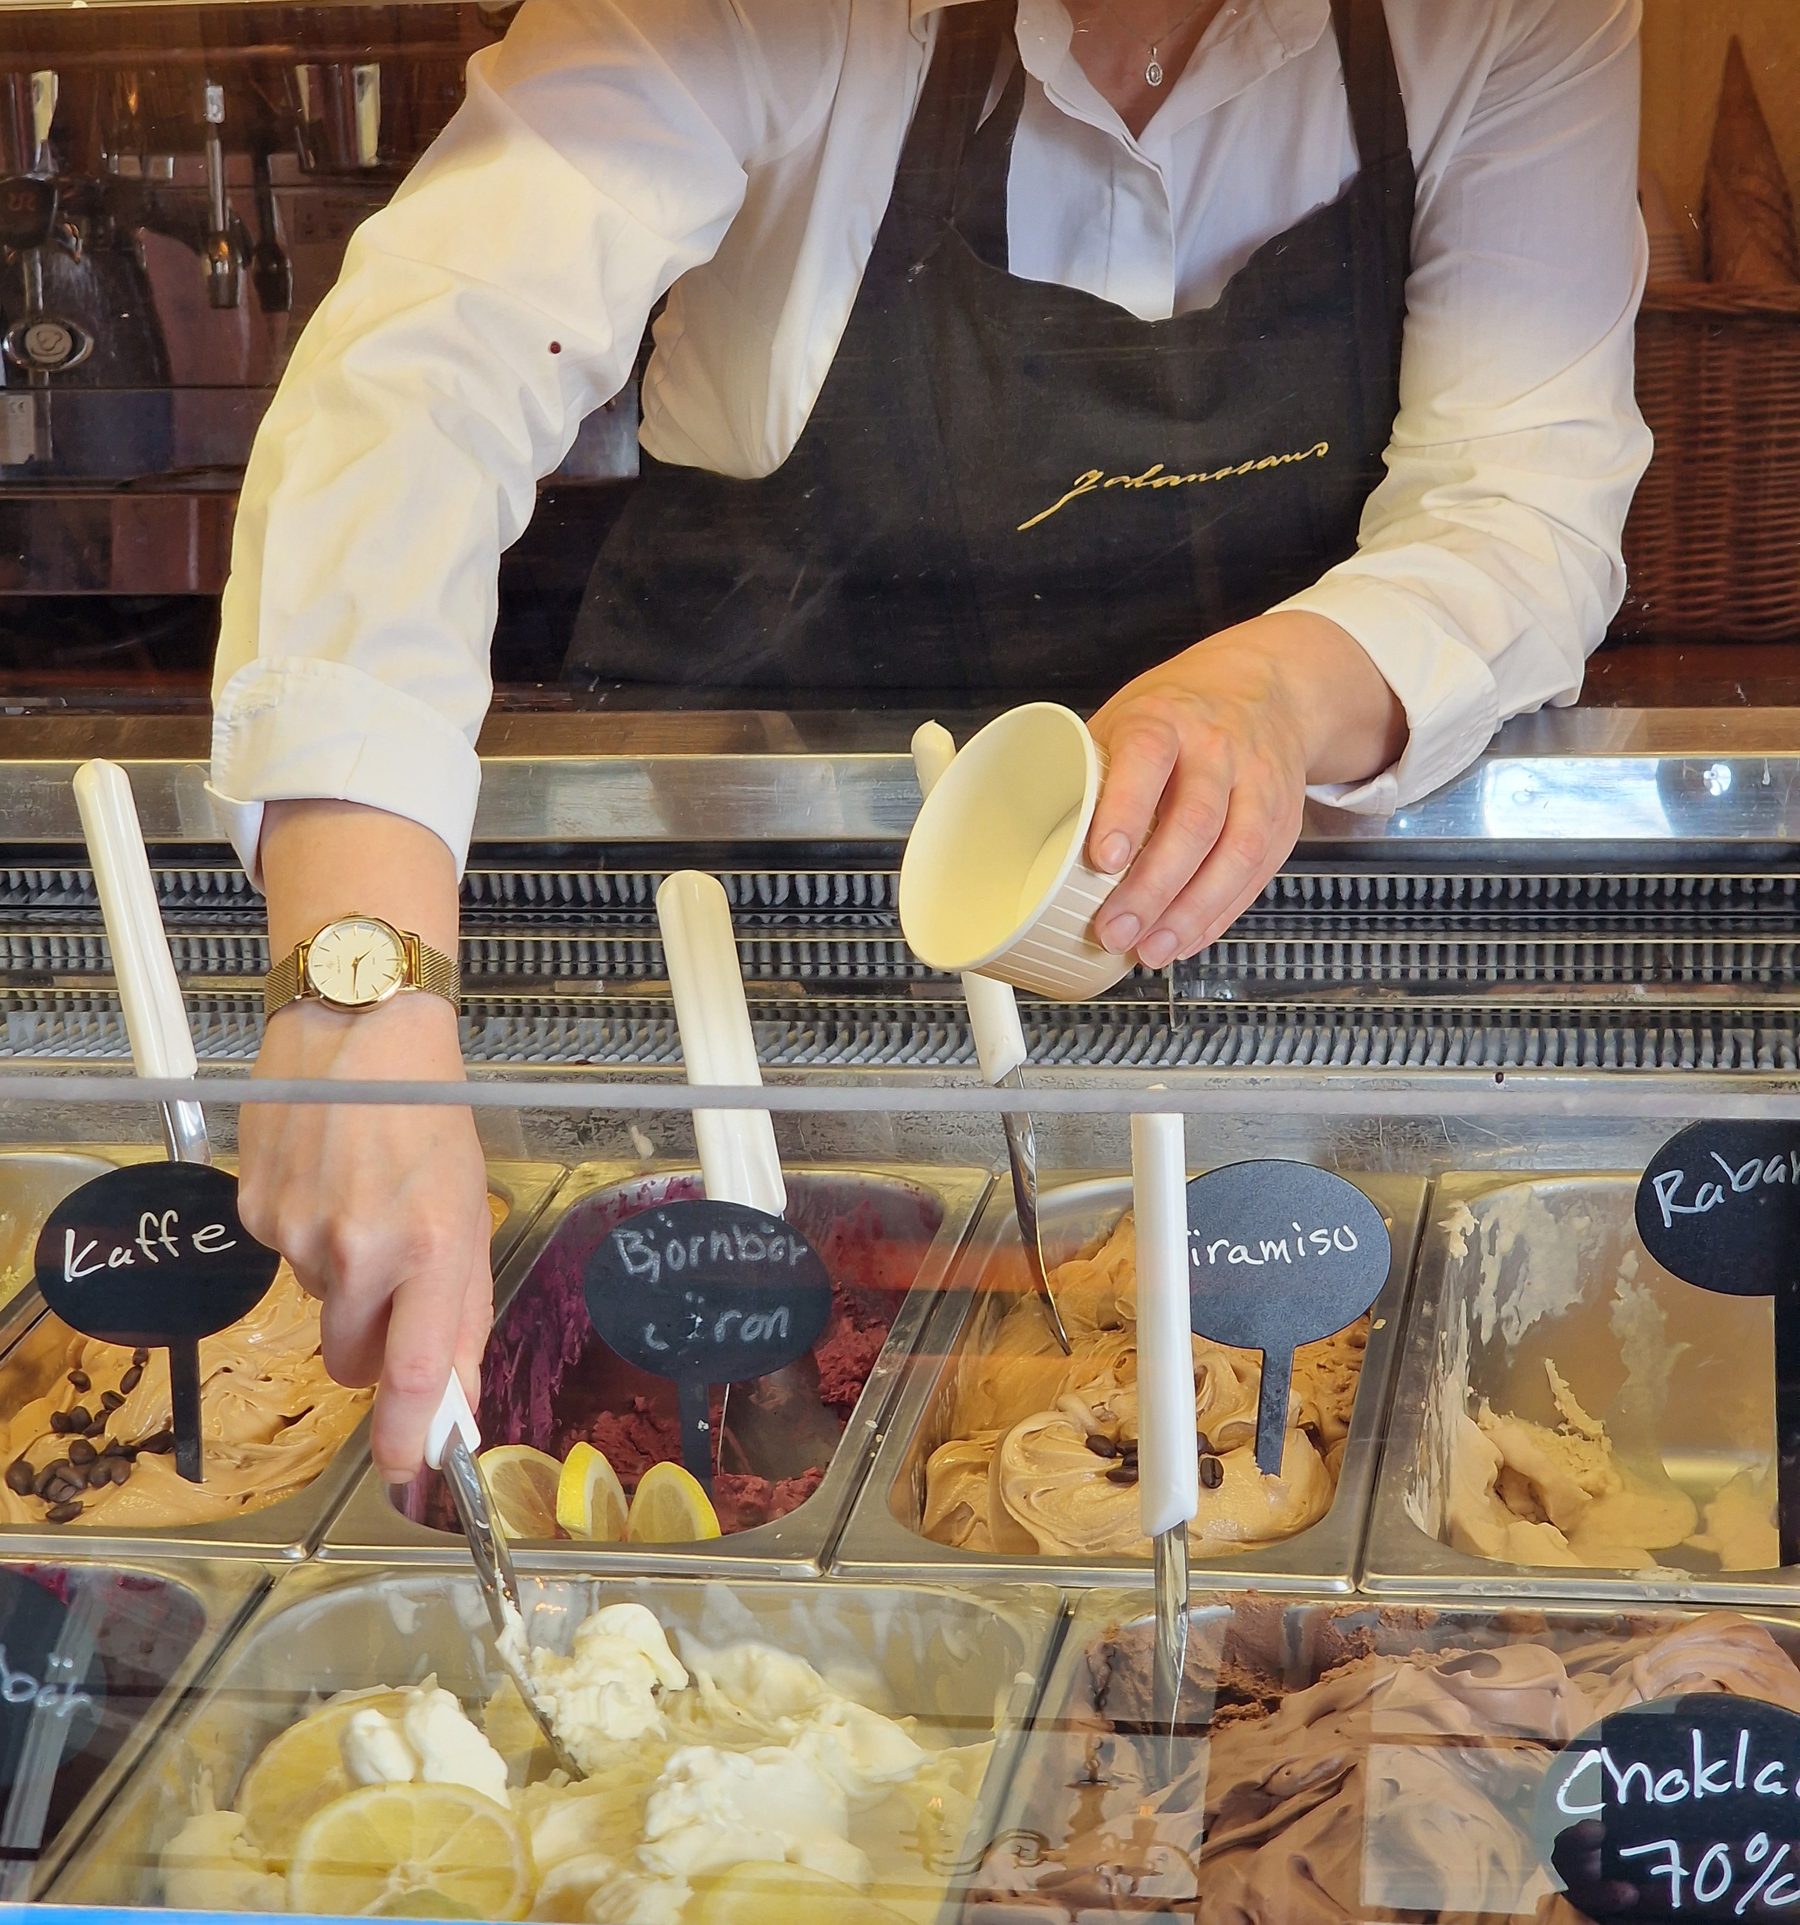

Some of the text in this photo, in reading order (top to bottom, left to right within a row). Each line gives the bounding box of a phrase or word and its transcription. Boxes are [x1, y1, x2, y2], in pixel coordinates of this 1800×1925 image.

[64, 1209, 237, 1283] Kaffe
[1187, 1221, 1359, 1267] iramisu
[1556, 1728, 1800, 1814] Chokla
[1619, 1831, 1800, 1915] 70%
